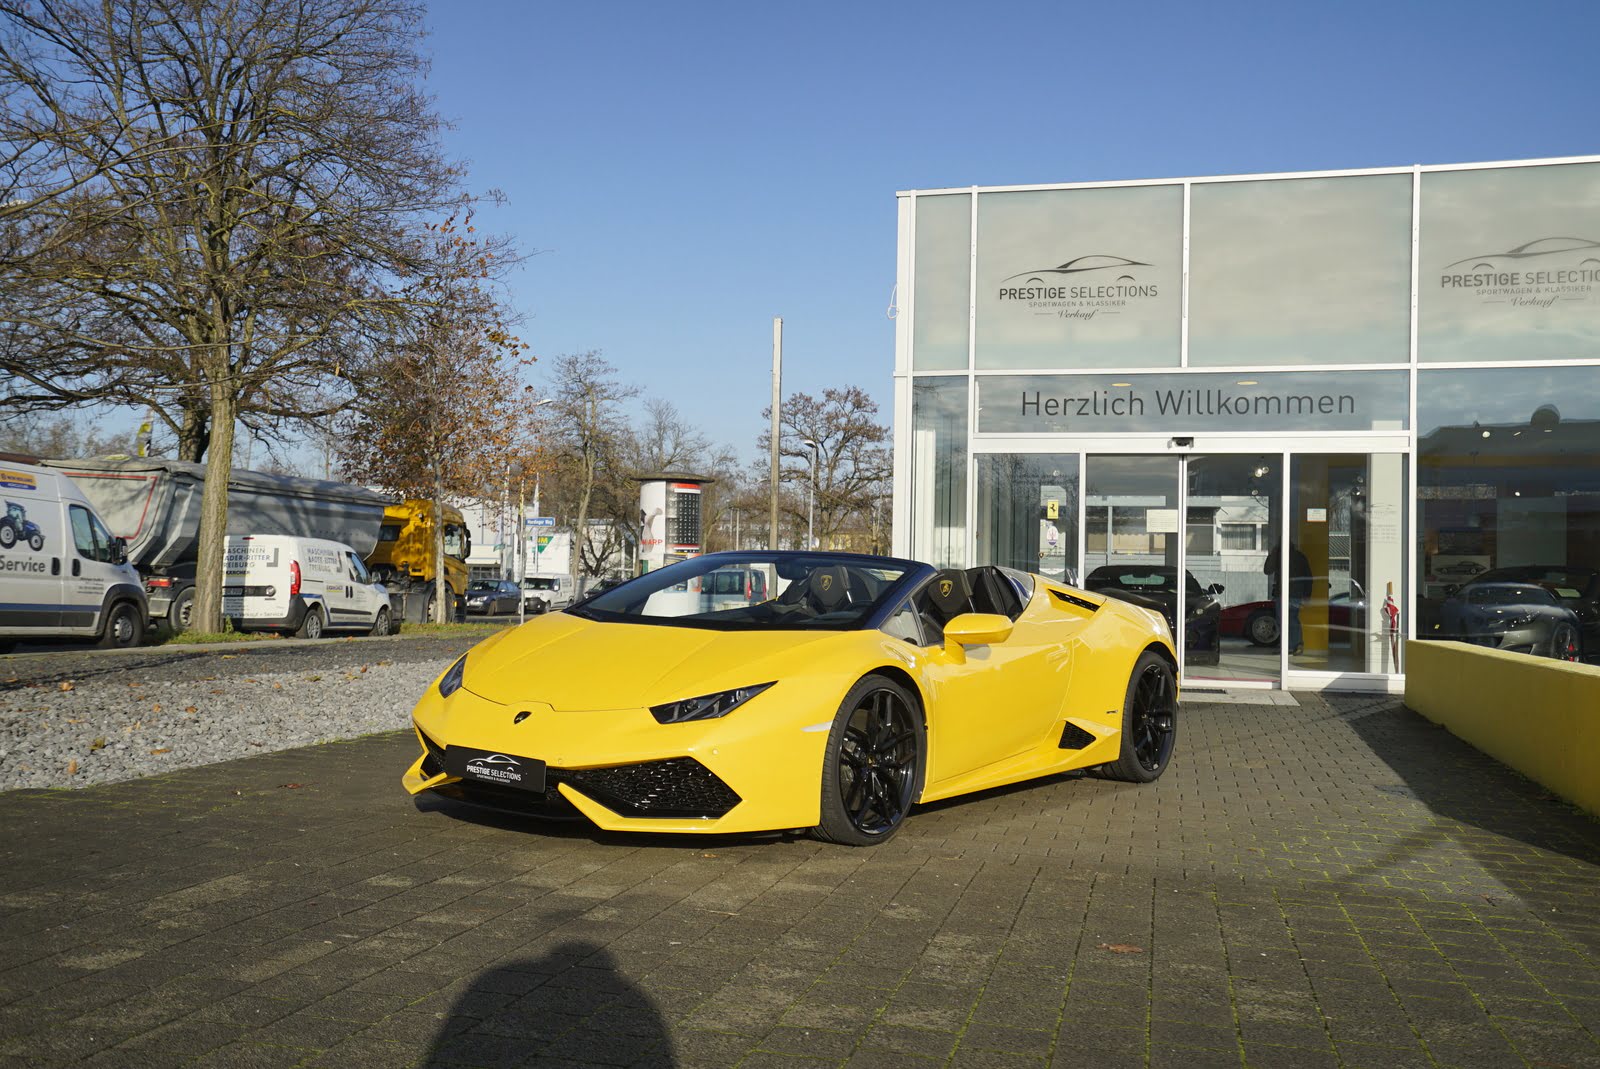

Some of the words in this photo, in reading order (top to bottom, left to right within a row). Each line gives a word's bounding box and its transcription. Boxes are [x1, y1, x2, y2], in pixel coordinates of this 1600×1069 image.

[1441, 272, 1520, 288] PRESTIGE
[999, 287, 1066, 300] PRESTIGE
[1070, 285, 1158, 298] SELECTIONS
[1476, 287, 1532, 296] SPORTWAGEN
[1544, 285, 1592, 293] KLASSIKER
[1510, 295, 1559, 308] Verkauf
[1057, 309, 1099, 320] Verkauf
[1022, 390, 1144, 416] Herzlich
[1155, 389, 1355, 416] Willkommen
[0, 554, 46, 573] Service
[466, 765, 490, 776] PRESTIGE
[490, 769, 522, 782] SELECTIONS
